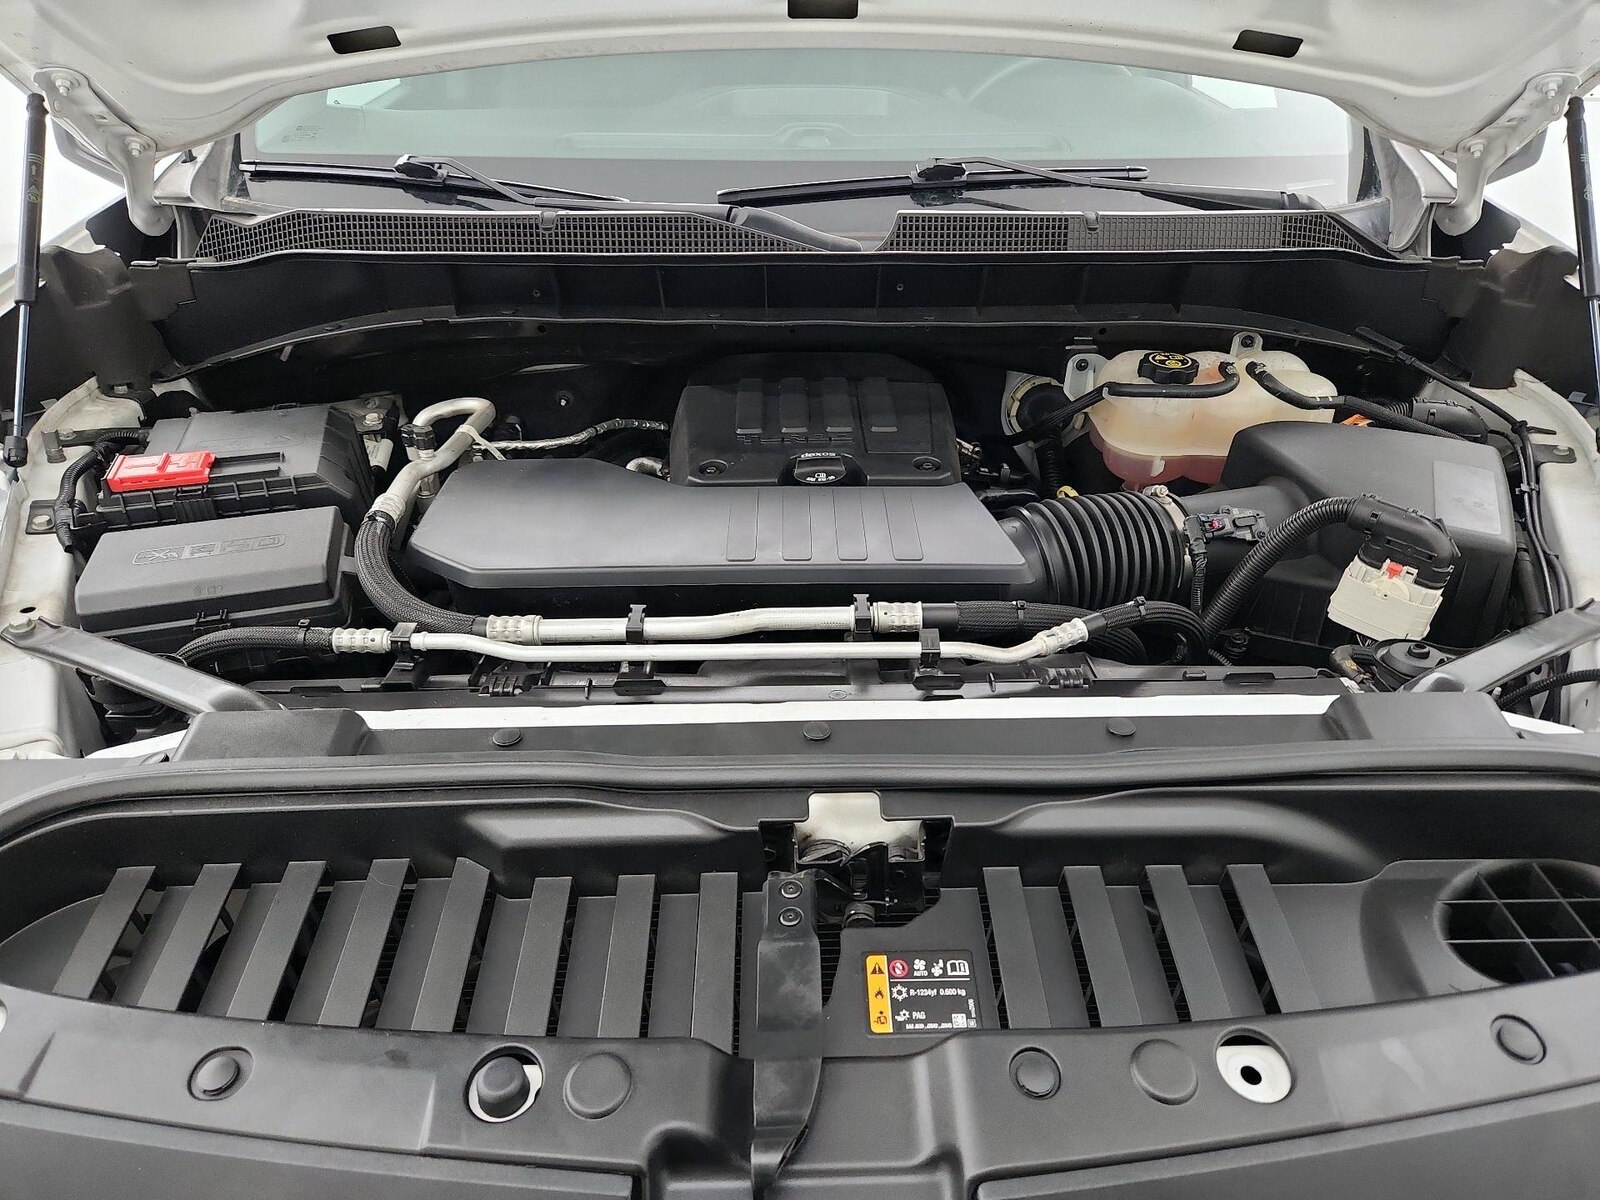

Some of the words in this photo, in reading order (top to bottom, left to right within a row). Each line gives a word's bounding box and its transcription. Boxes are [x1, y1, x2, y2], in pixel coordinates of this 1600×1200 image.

[909, 988, 937, 997] R-1234yf
[957, 988, 966, 997] kg
[912, 1011, 926, 1020] PAG
